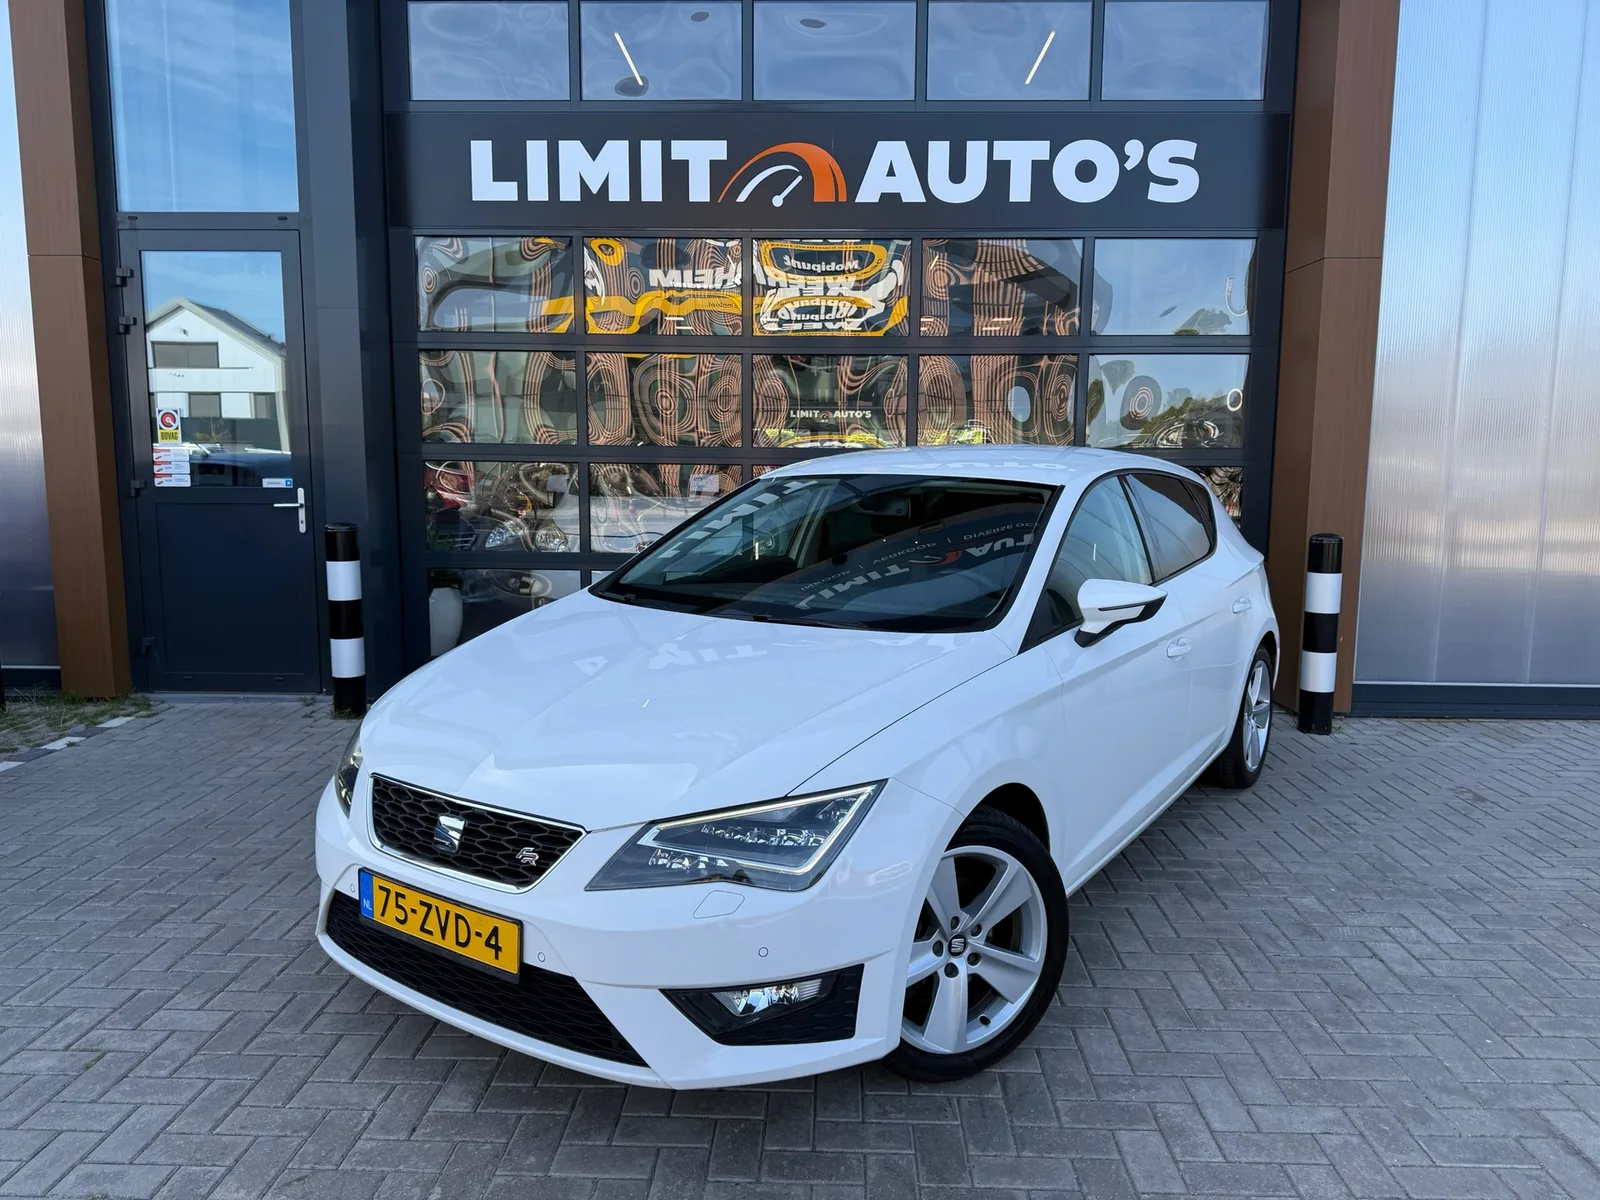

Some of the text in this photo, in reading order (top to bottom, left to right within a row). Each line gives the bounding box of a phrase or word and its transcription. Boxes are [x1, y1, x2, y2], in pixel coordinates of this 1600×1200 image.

[470, 139, 1200, 204] LIMIT AUTO'S
[790, 410, 872, 418] LIMIT AUTO'S
[363, 898, 373, 911] NL
[378, 885, 502, 960] 75-ZVD-4
